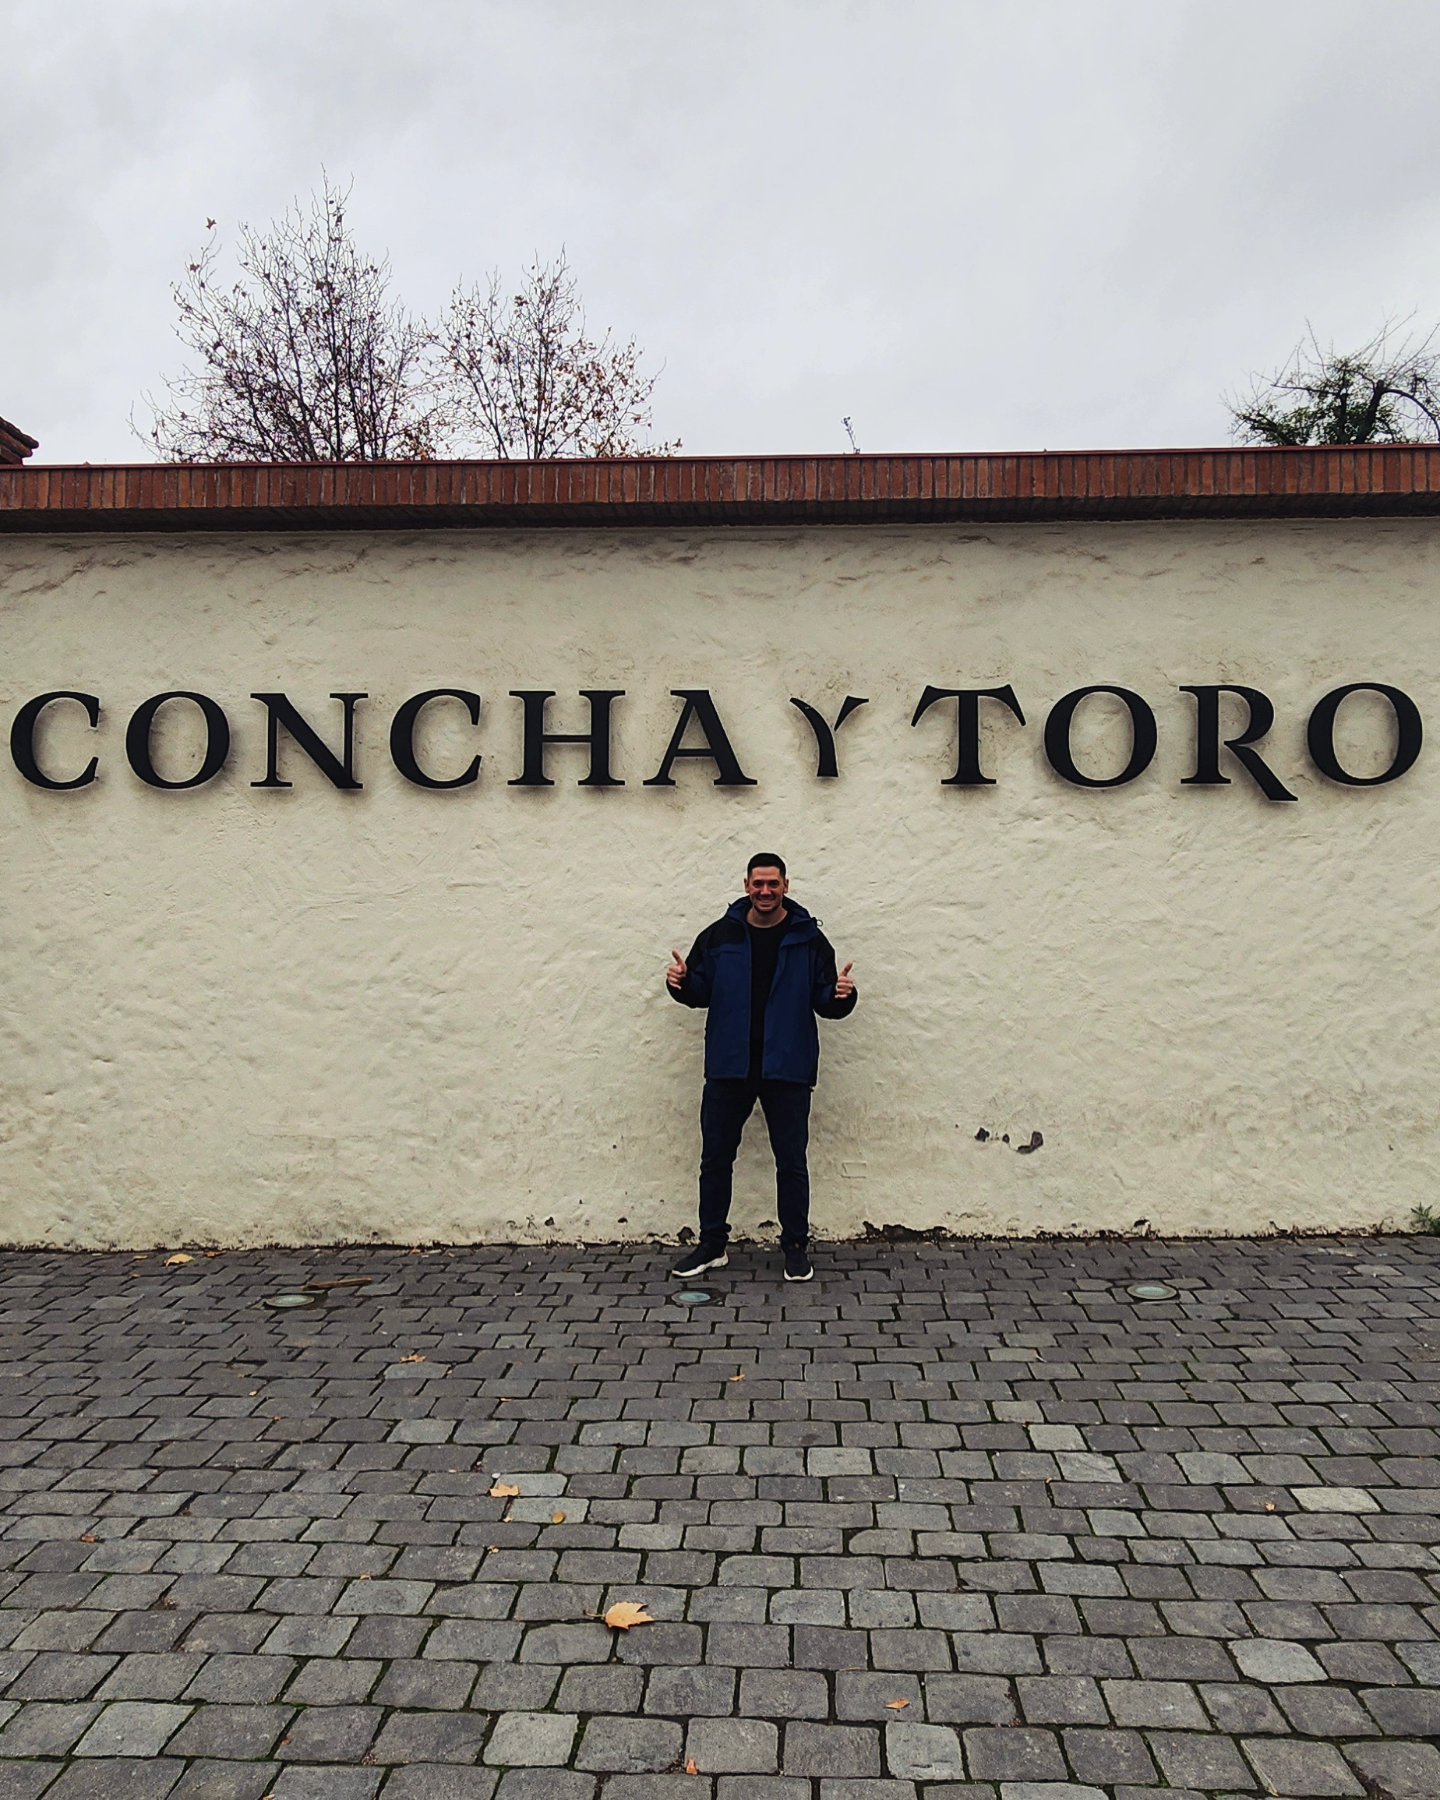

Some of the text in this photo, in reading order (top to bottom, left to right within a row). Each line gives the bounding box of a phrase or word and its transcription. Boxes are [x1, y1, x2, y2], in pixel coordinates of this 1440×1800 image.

[10, 682, 1424, 802] CONCHA Y TORO
